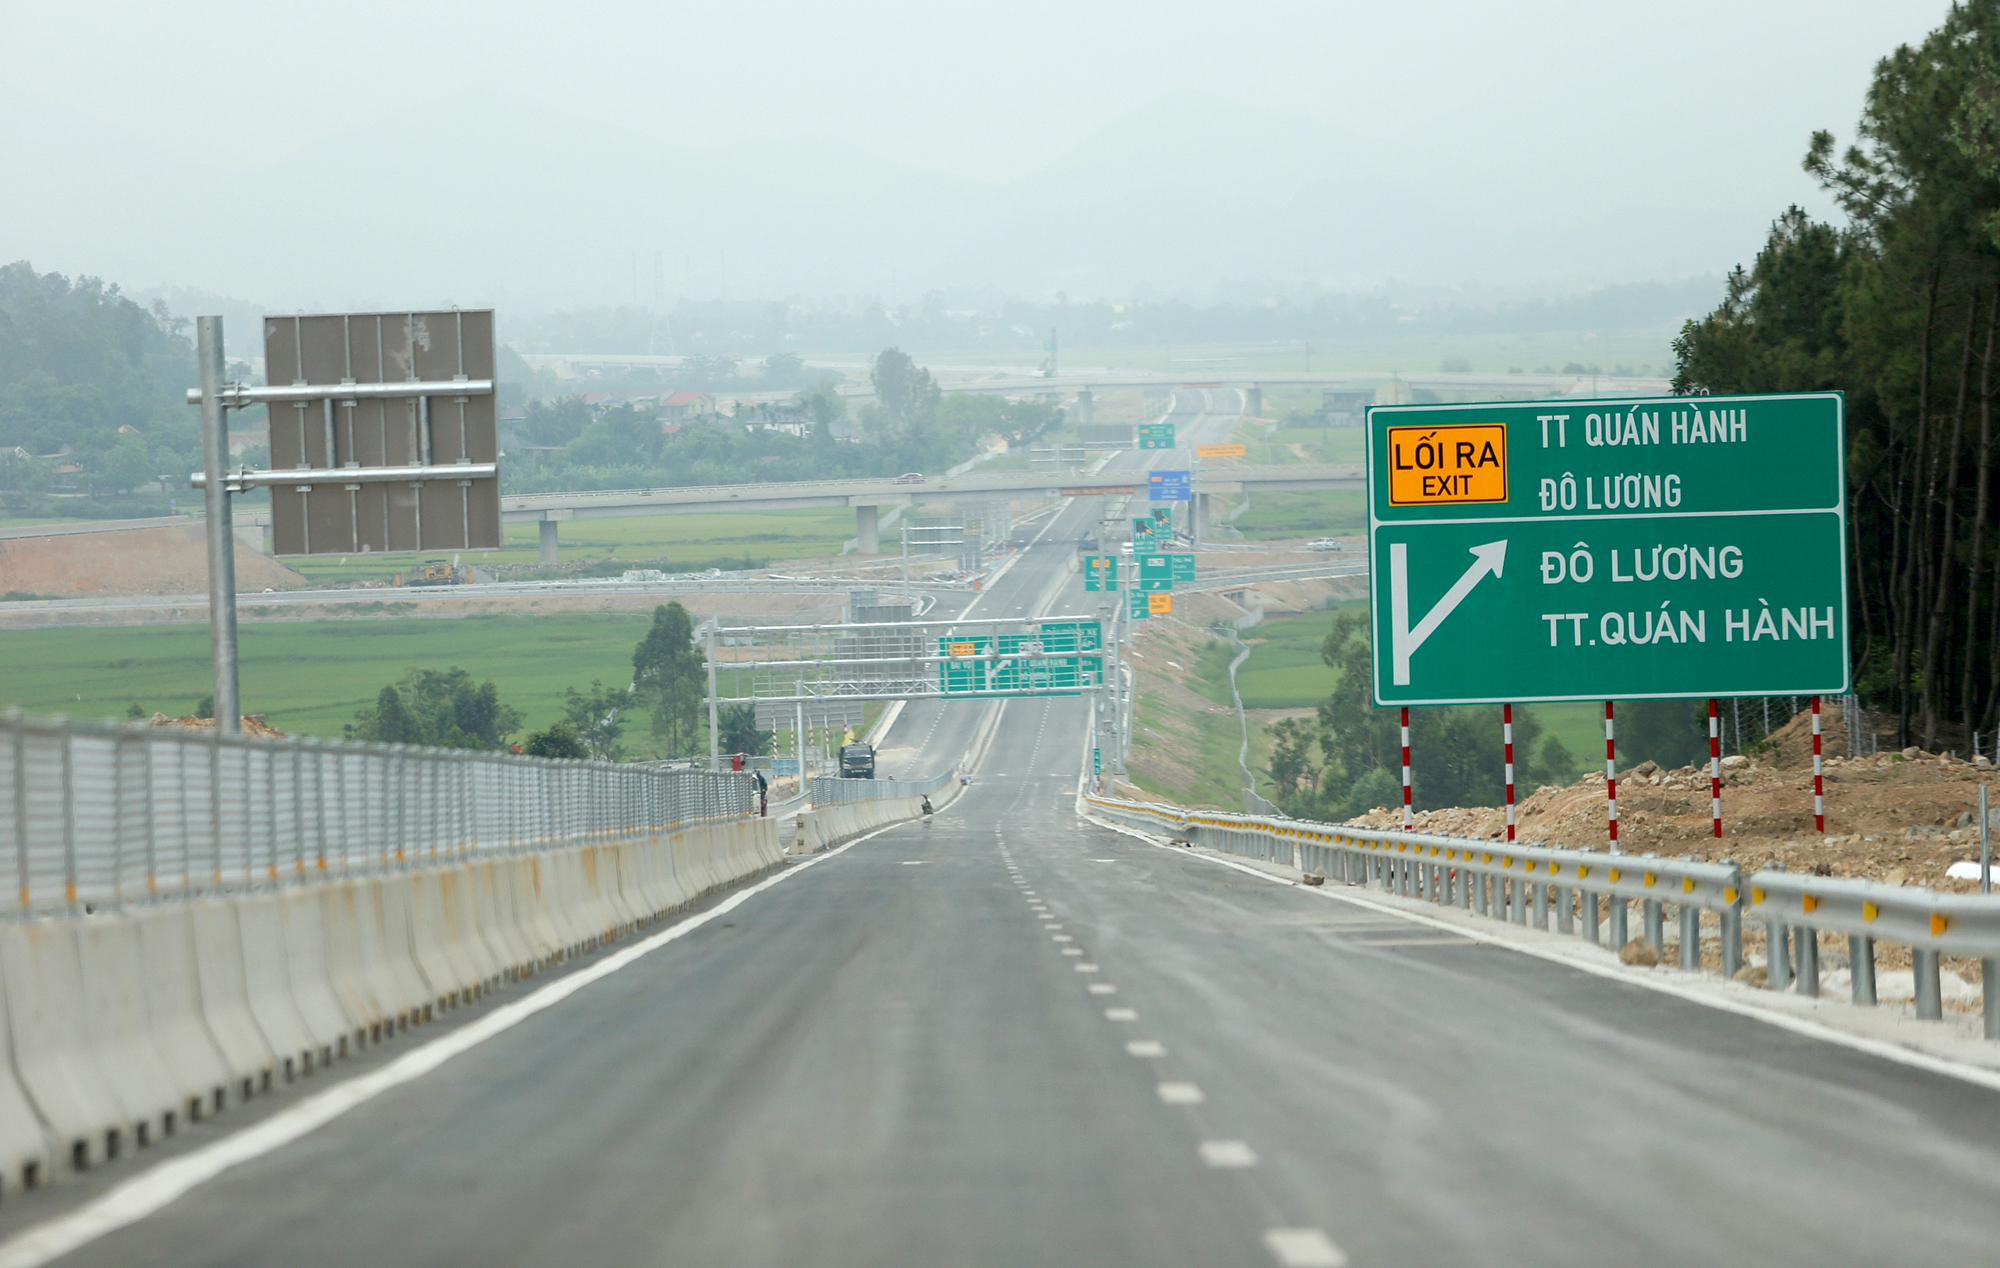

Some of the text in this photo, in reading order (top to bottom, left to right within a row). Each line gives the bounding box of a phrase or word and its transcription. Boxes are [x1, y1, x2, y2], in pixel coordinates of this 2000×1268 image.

[1537, 403, 1747, 448] TT QUÁN HÀNH
[1395, 431, 1500, 471] LỐI RA
[1423, 475, 1473, 497] EXIT
[1539, 472, 1681, 511] ĐÔ LƯƠNG
[1540, 542, 1744, 584] ĐÔ LƯƠNG
[1542, 598, 1834, 647] TT.QUÁN HÀNH
